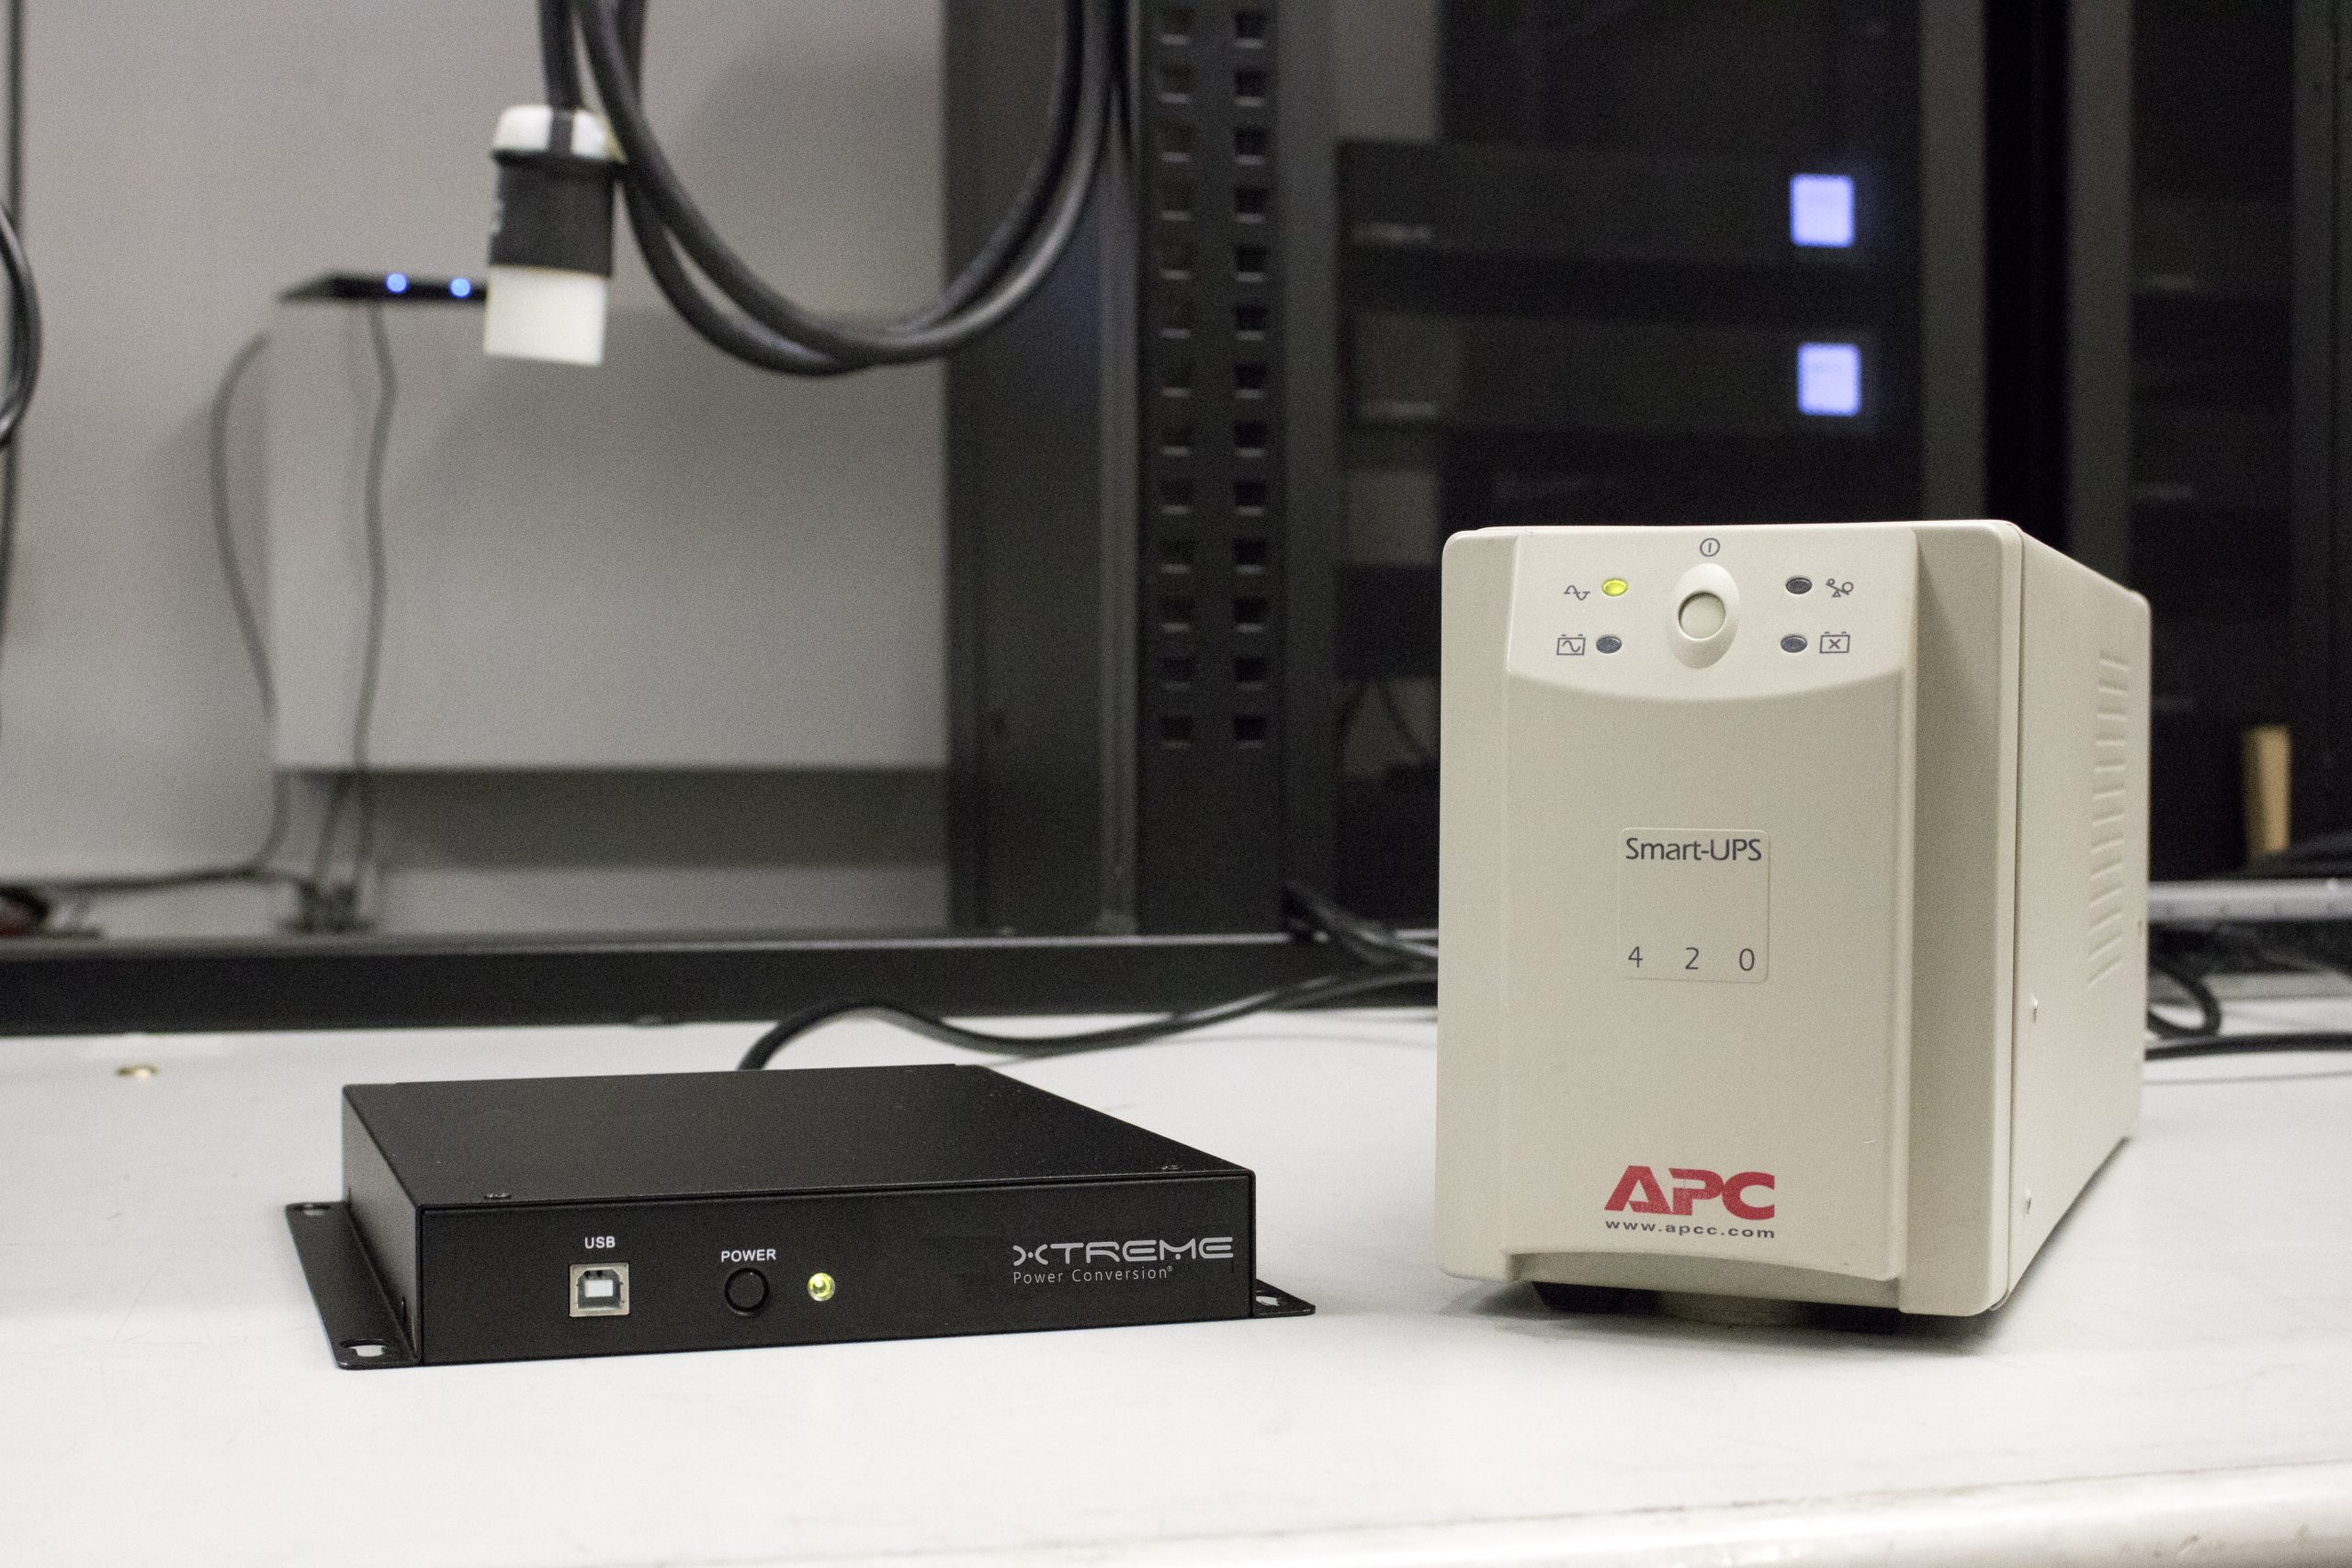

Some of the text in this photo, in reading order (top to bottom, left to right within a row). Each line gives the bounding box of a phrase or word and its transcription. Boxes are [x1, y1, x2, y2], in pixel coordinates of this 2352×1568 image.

[1625, 838, 1762, 862] Smart-UPS
[1603, 1165, 1775, 1221] APC
[1604, 1220, 1776, 1239] www.apcc.com
[584, 1235, 616, 1249] USB
[1012, 1236, 1234, 1267] XTREME
[720, 1248, 777, 1263] POWER
[1012, 1270, 1063, 1285] Power
